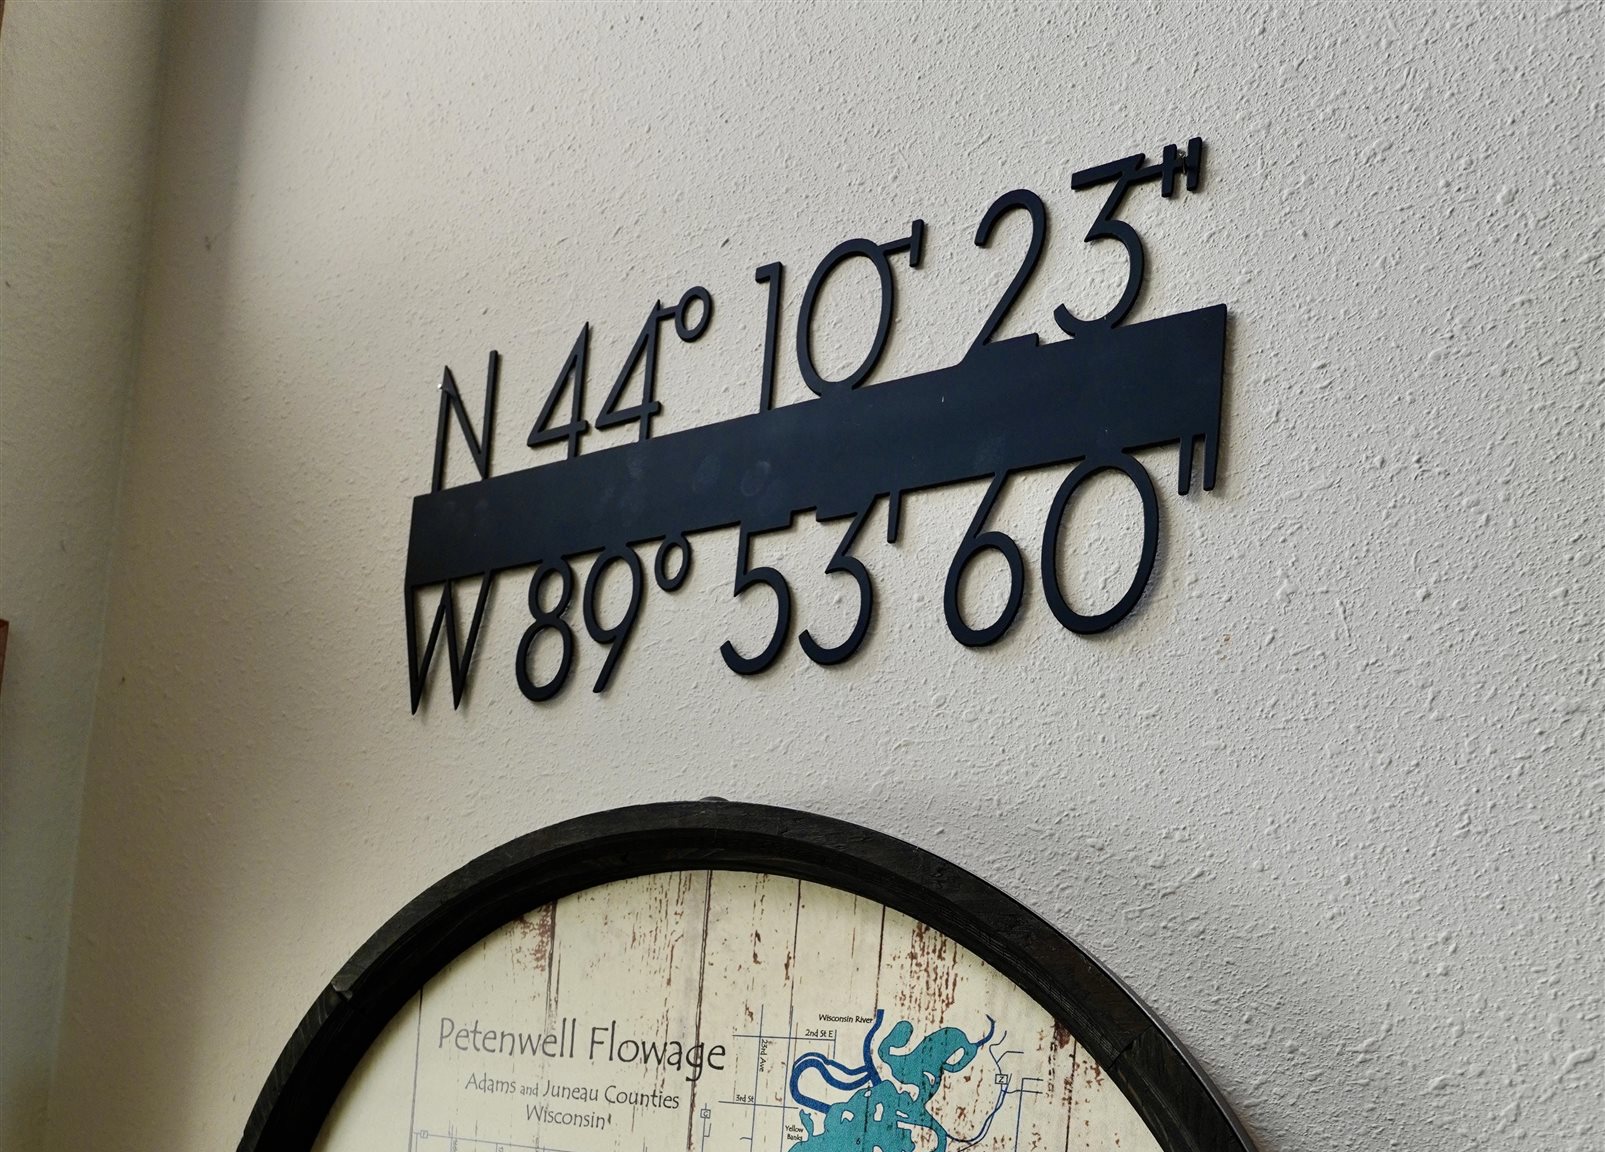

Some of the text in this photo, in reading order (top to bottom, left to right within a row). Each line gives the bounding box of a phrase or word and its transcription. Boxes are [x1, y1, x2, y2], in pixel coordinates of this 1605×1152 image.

[432, 349, 498, 492] N
[407, 571, 493, 714] W
[805, 1029, 818, 1037] 2nd
[820, 1029, 828, 1038] St
[818, 1013, 874, 1024] Wisconsin River
[438, 1017, 726, 1082] Petenwell Flowage
[759, 1039, 769, 1072] 23rd Ave
[465, 1072, 680, 1109] Adams and Juneau Counties
[526, 1104, 606, 1130] Wisconsin
[785, 1125, 804, 1133] Yellow
